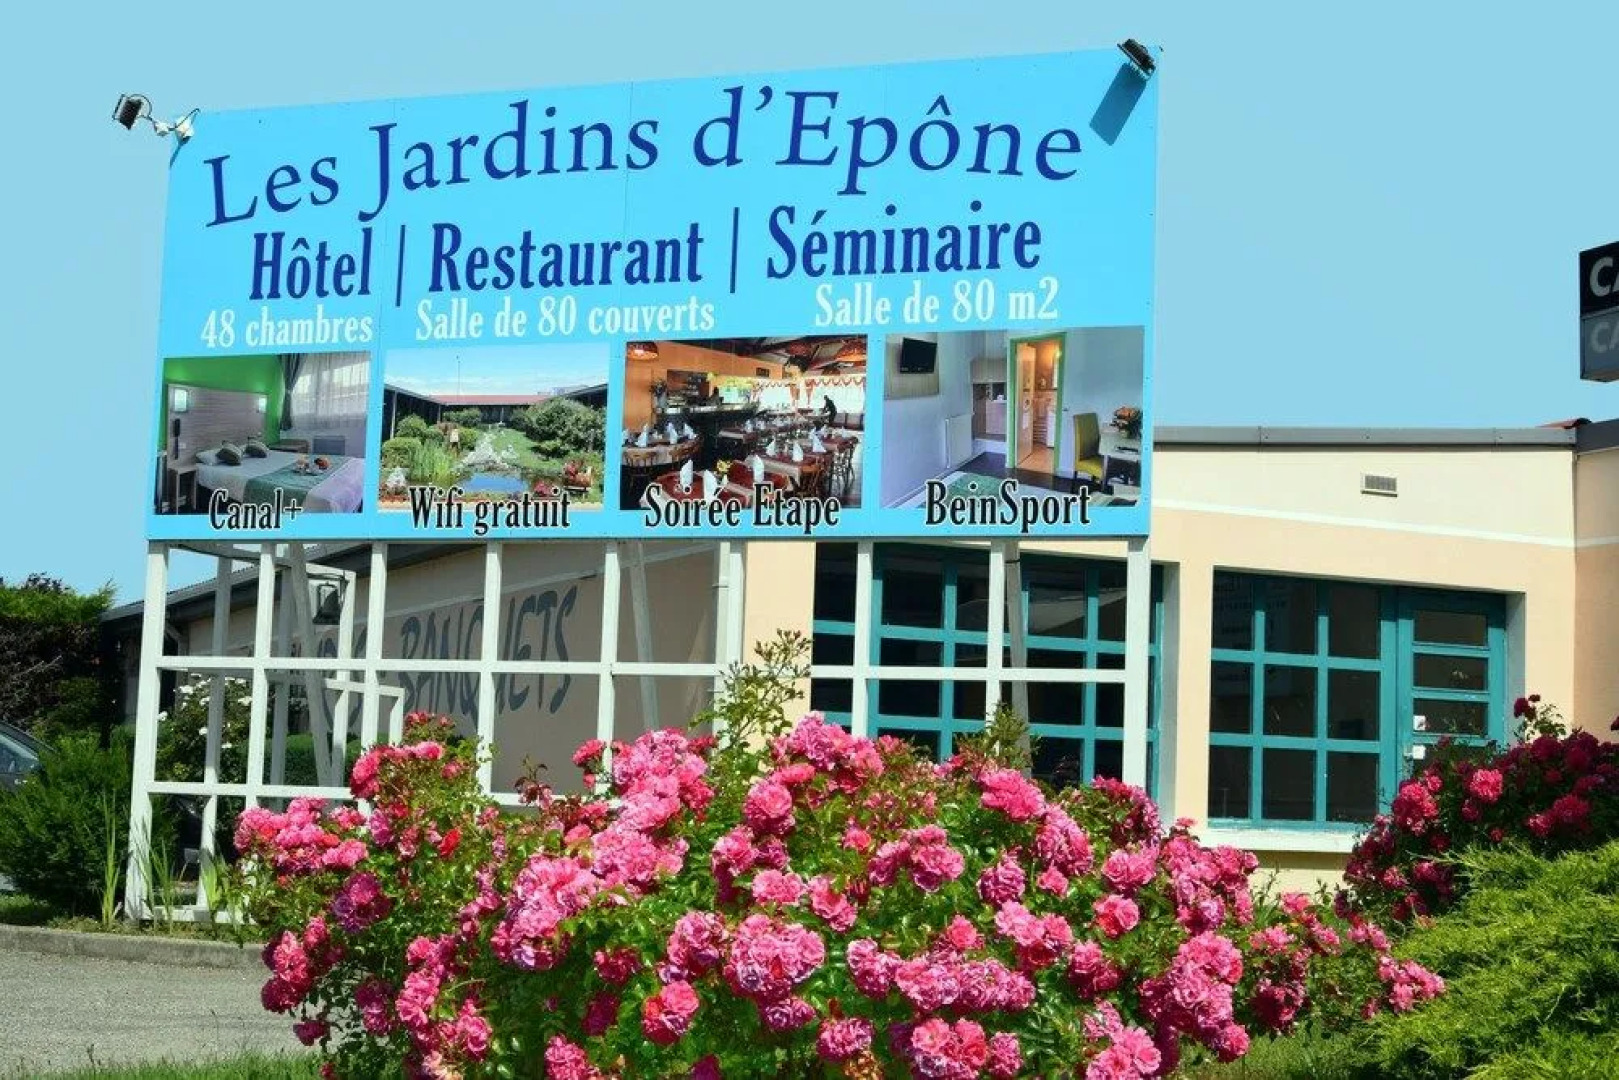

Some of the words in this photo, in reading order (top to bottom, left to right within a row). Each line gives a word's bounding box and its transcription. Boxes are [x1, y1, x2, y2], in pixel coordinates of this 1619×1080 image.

[204, 154, 339, 227] Les
[358, 100, 659, 222] Jardins
[249, 226, 373, 300] Hôtel
[429, 222, 705, 293] Restaurant
[766, 200, 1042, 280] Séminaire
[201, 309, 236, 348] 48
[245, 304, 373, 347] chambres
[415, 297, 483, 341] Salle
[493, 295, 528, 338] de
[538, 295, 577, 336] 80
[588, 294, 716, 334] couverts
[814, 282, 893, 327] Salle
[903, 284, 941, 325] de
[952, 279, 997, 322] 80
[1008, 276, 1060, 320] m2
[208, 487, 303, 531] Canal+
[408, 486, 465, 528] Wifi
[474, 488, 571, 536] gratuit
[644, 484, 741, 528] Soirée
[751, 482, 841, 535] Etape
[924, 480, 1092, 533] BeinSport
